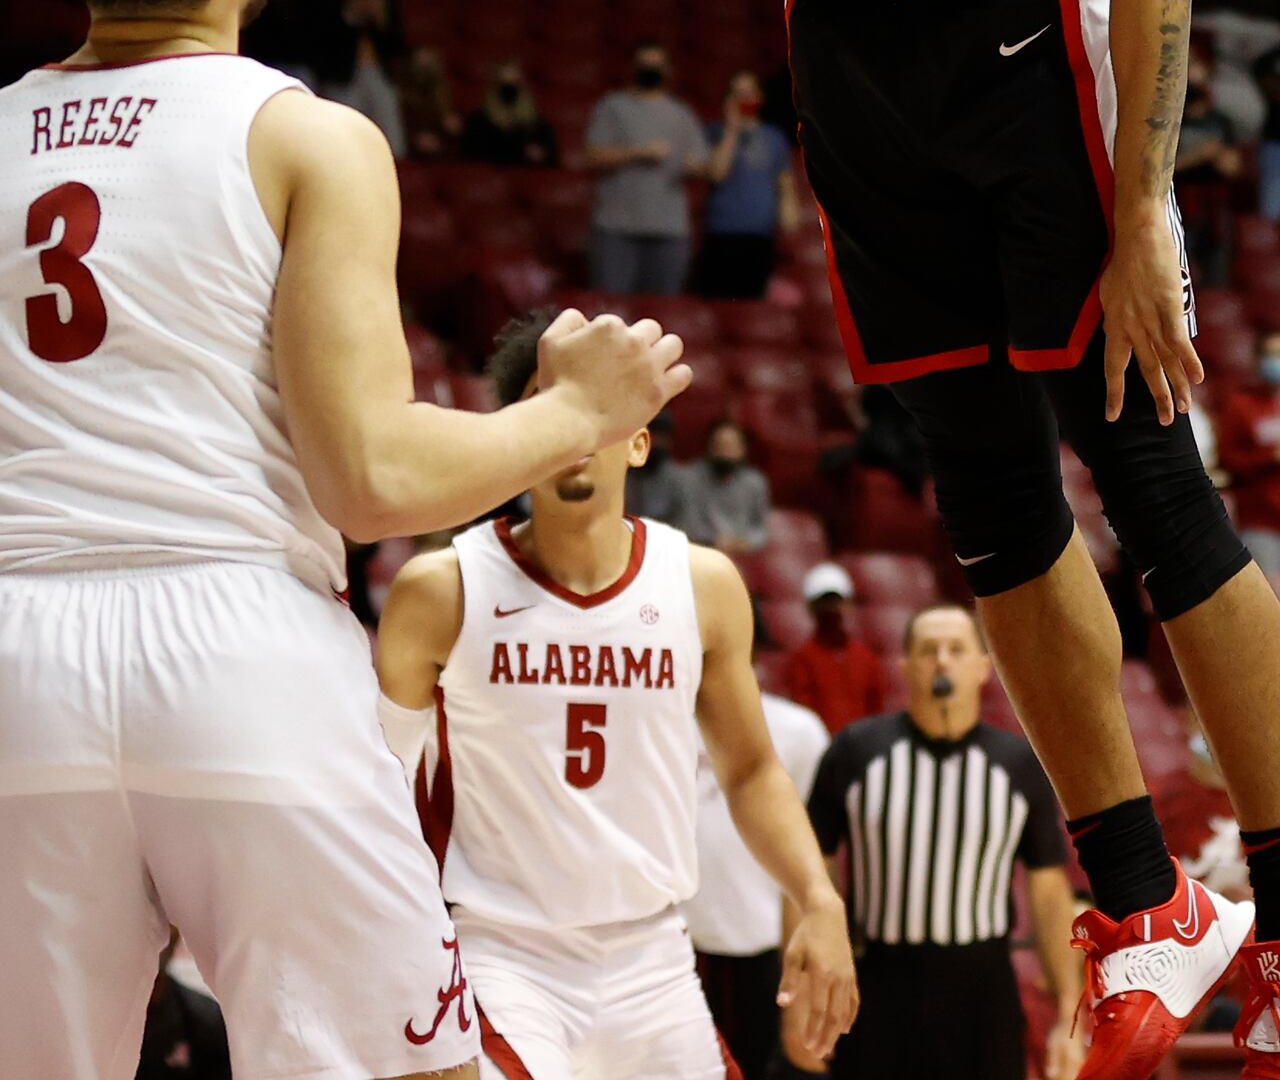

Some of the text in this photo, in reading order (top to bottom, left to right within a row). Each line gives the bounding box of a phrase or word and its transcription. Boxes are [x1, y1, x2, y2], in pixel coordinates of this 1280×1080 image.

[30, 95, 158, 156] REESE
[25, 181, 108, 363] 3
[489, 642, 675, 689] ALABAMA
[564, 702, 608, 790] 5
[404, 935, 472, 1046] A
